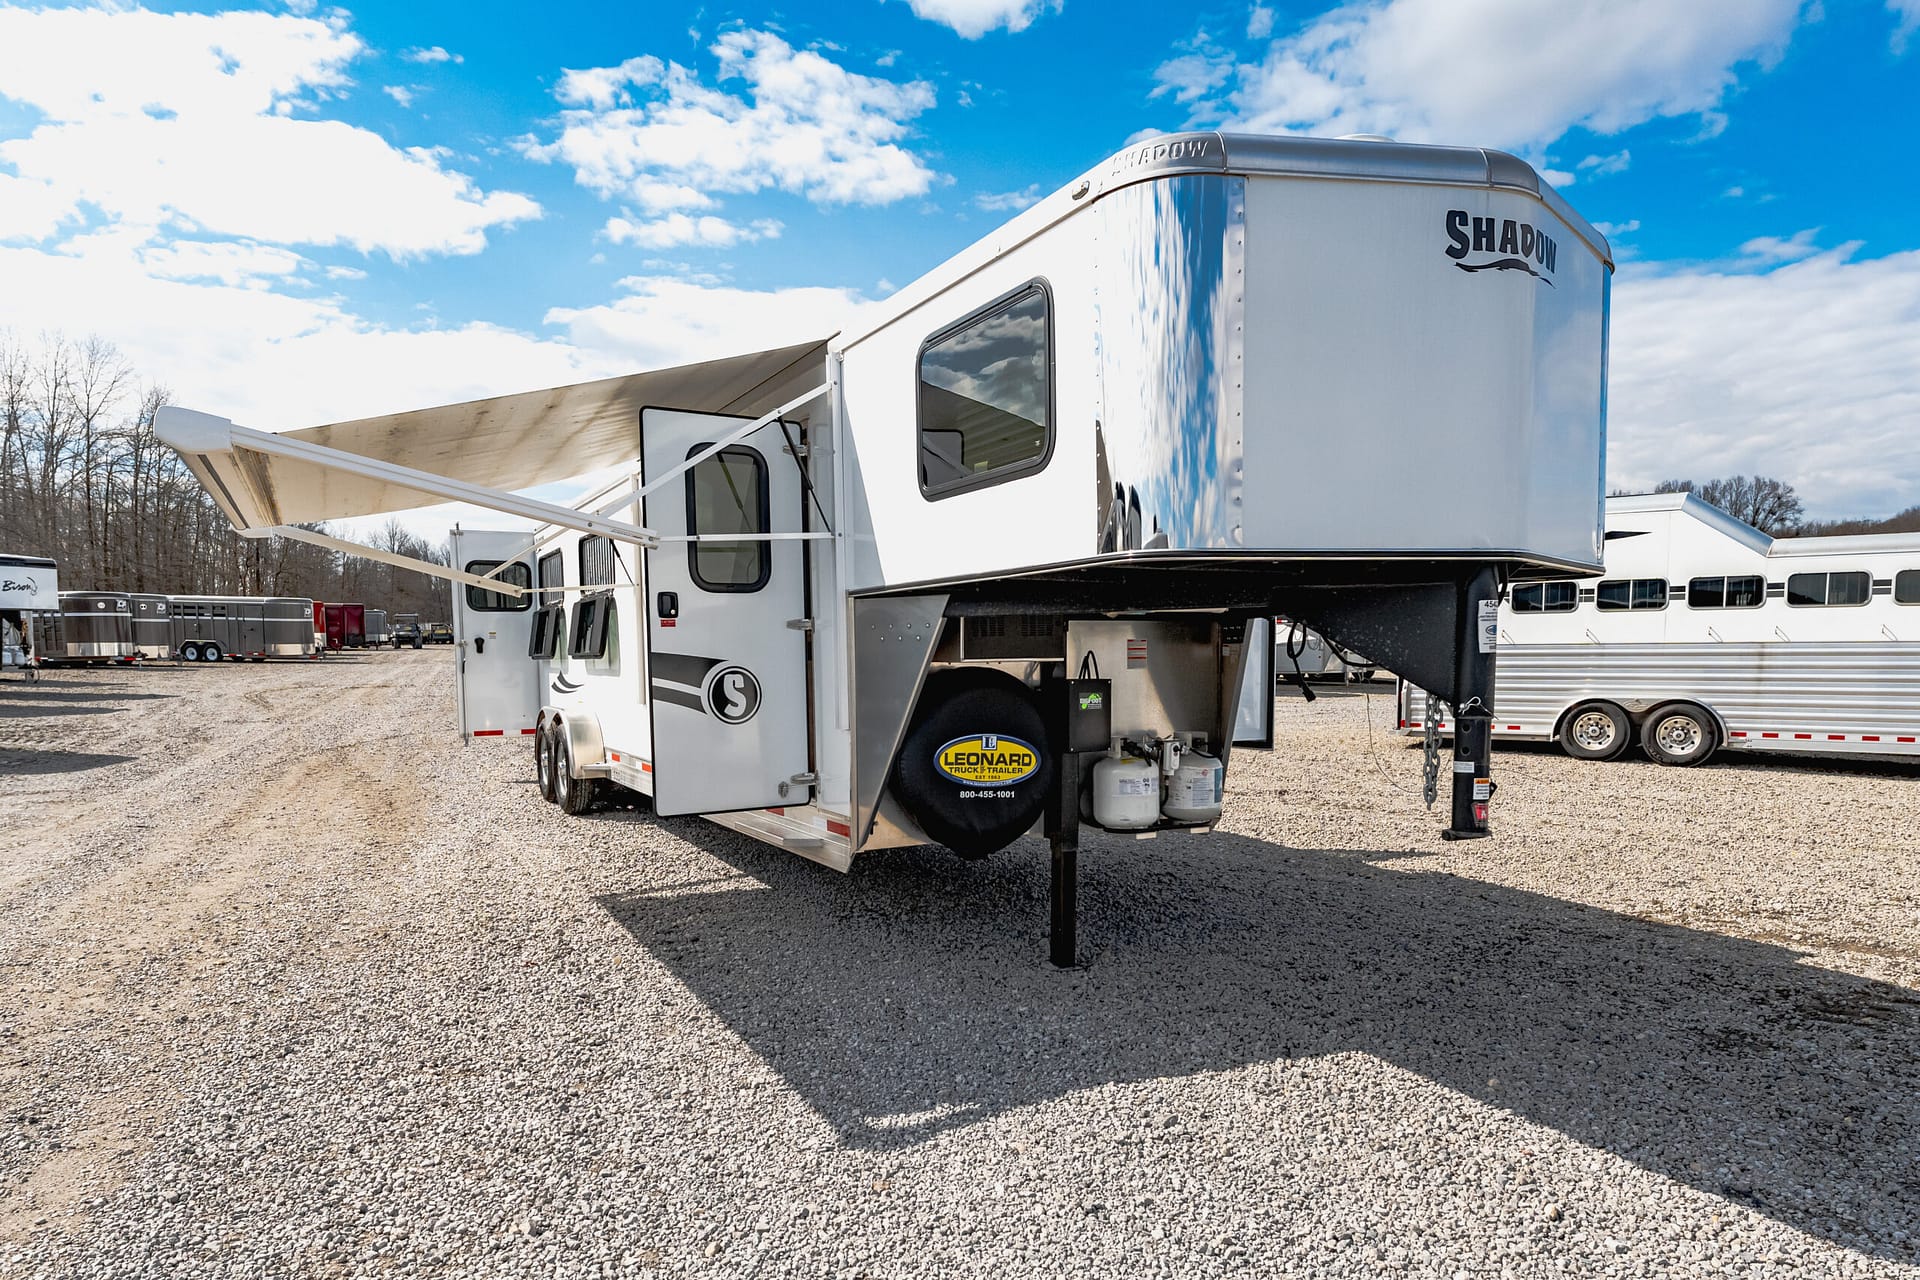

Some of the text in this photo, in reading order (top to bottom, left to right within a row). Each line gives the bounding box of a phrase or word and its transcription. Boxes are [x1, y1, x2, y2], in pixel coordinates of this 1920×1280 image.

[1112, 140, 1208, 176] SHADOW
[1445, 210, 1557, 274] SHADOW
[2, 580, 31, 591] Bison
[723, 674, 747, 717] S
[944, 752, 1032, 767] LEONARD
[949, 766, 978, 774] TRUCK
[987, 766, 1023, 774] TRAILER
[960, 790, 1015, 798] 800-455-1001
